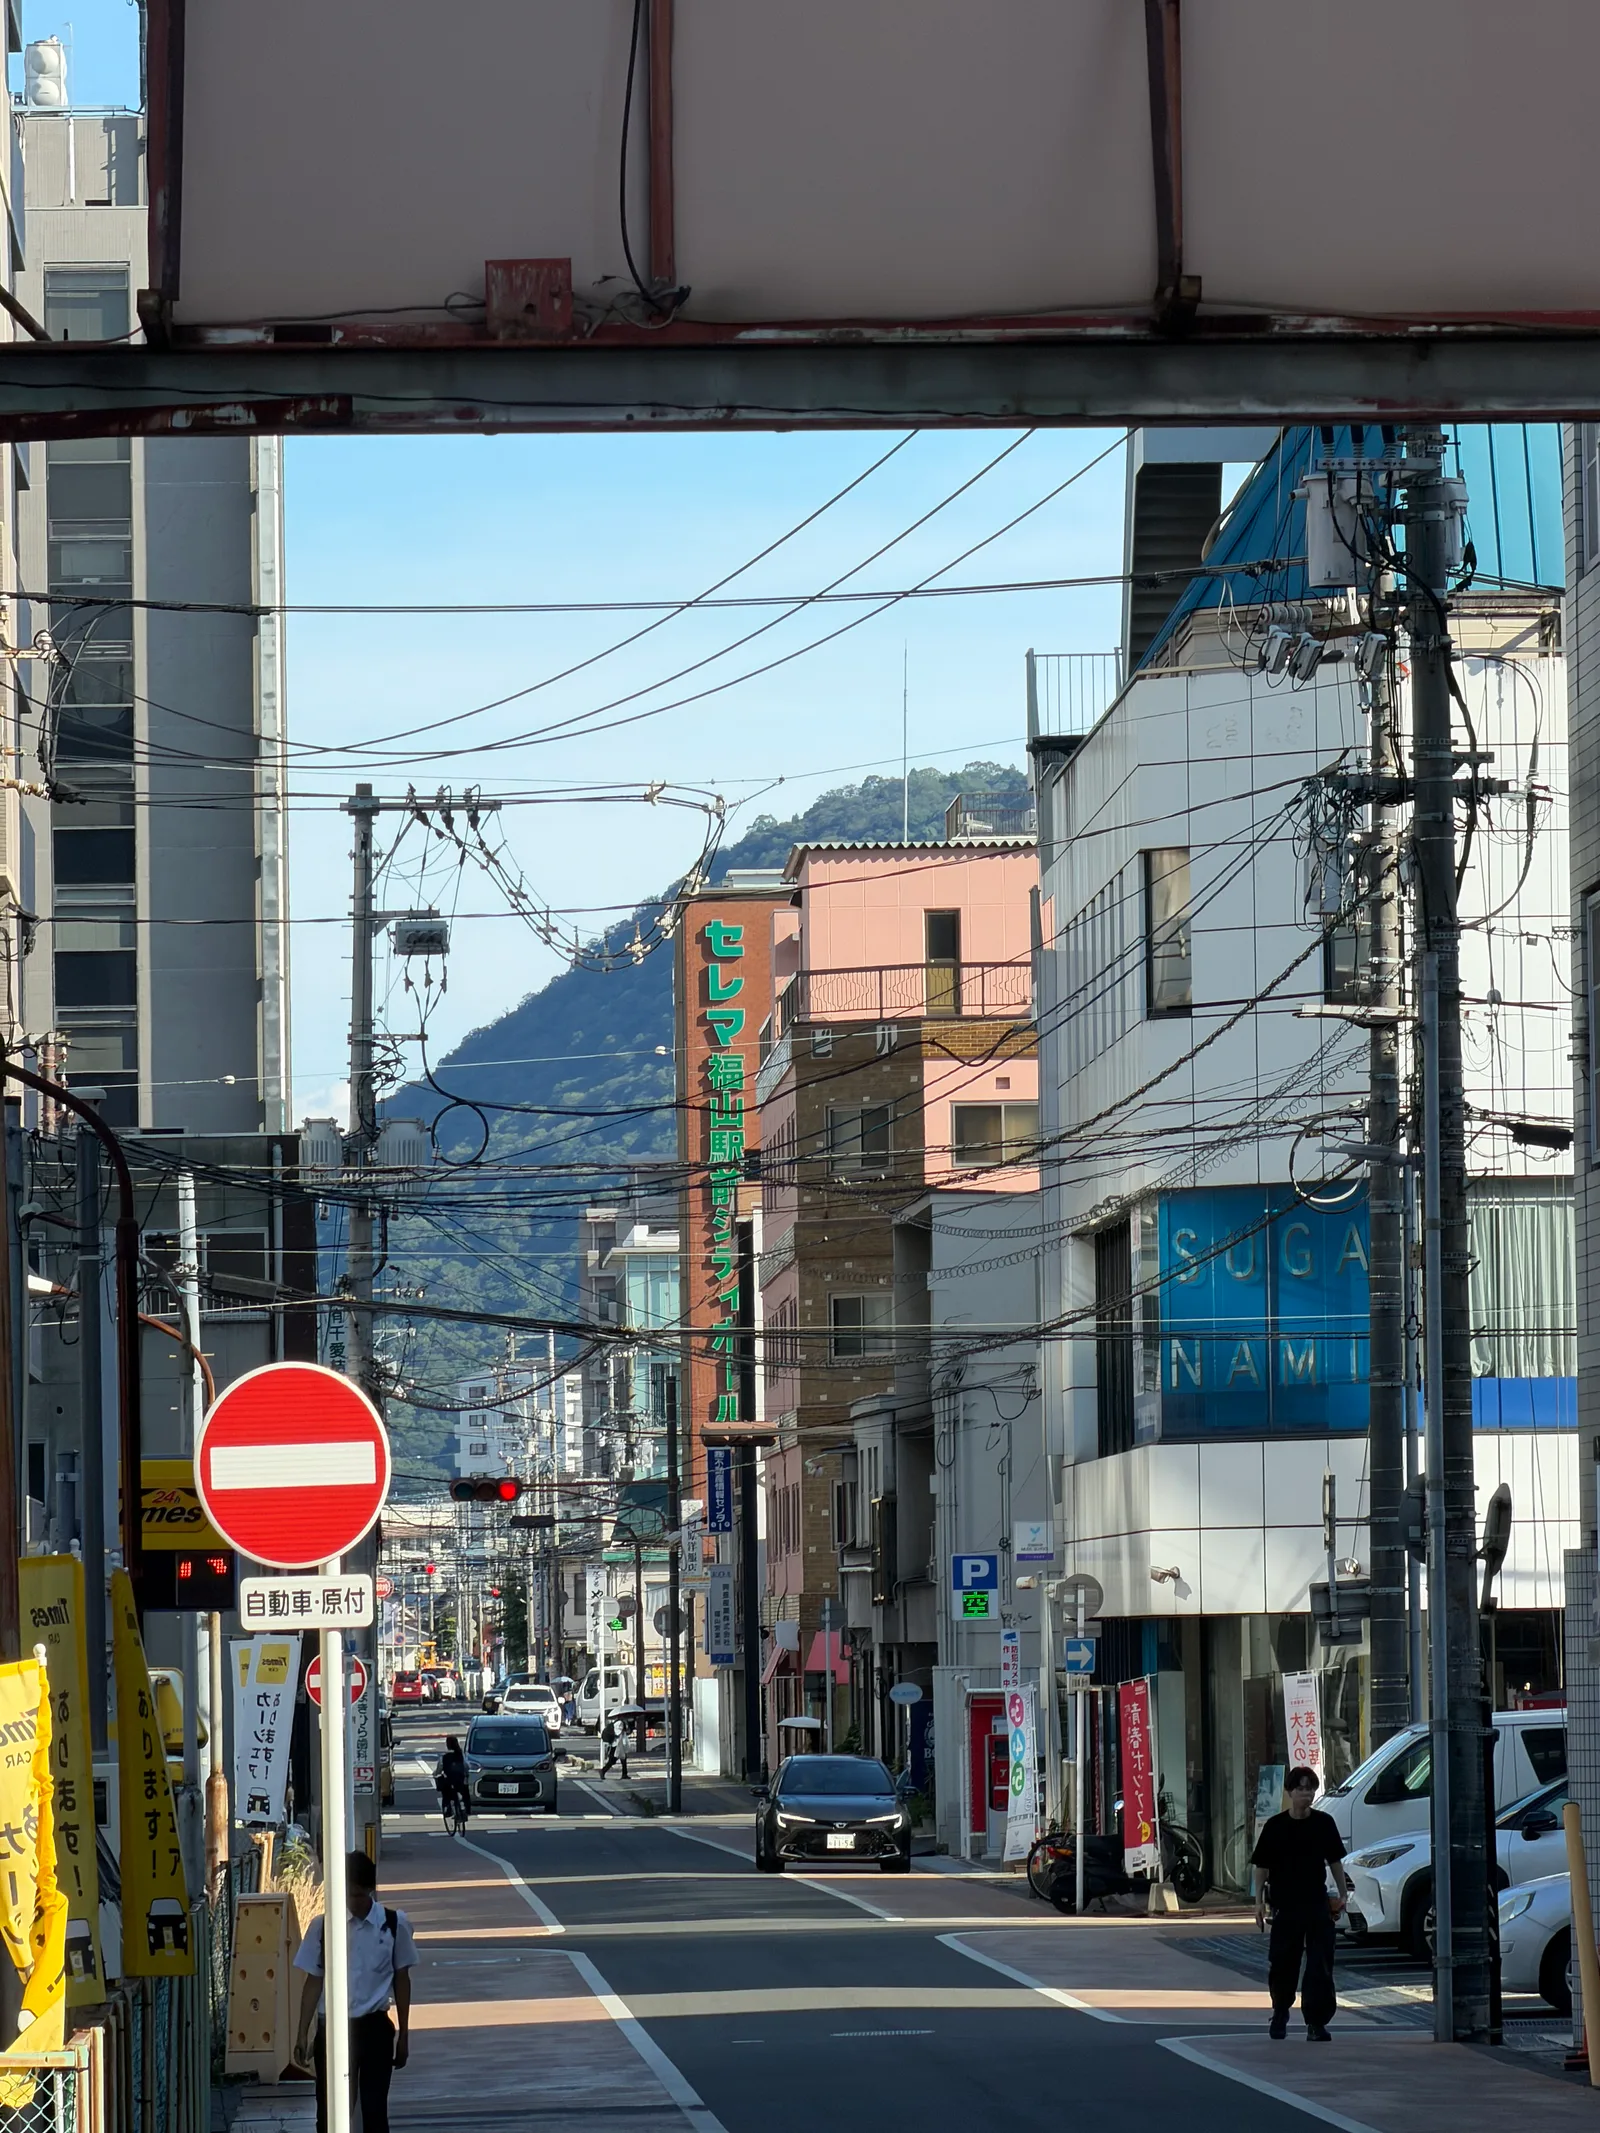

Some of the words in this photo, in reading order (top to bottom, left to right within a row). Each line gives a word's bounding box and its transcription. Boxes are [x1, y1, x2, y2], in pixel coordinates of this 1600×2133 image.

[1171, 1222, 1369, 1282] SUGA
[1171, 1333, 1360, 1389] NAMI
[962, 1559, 990, 1587] P
[246, 1590, 366, 1617] 自動車・原付
[963, 1591, 990, 1618] 空
[1011, 1645, 1019, 1687] 防犯カメラ
